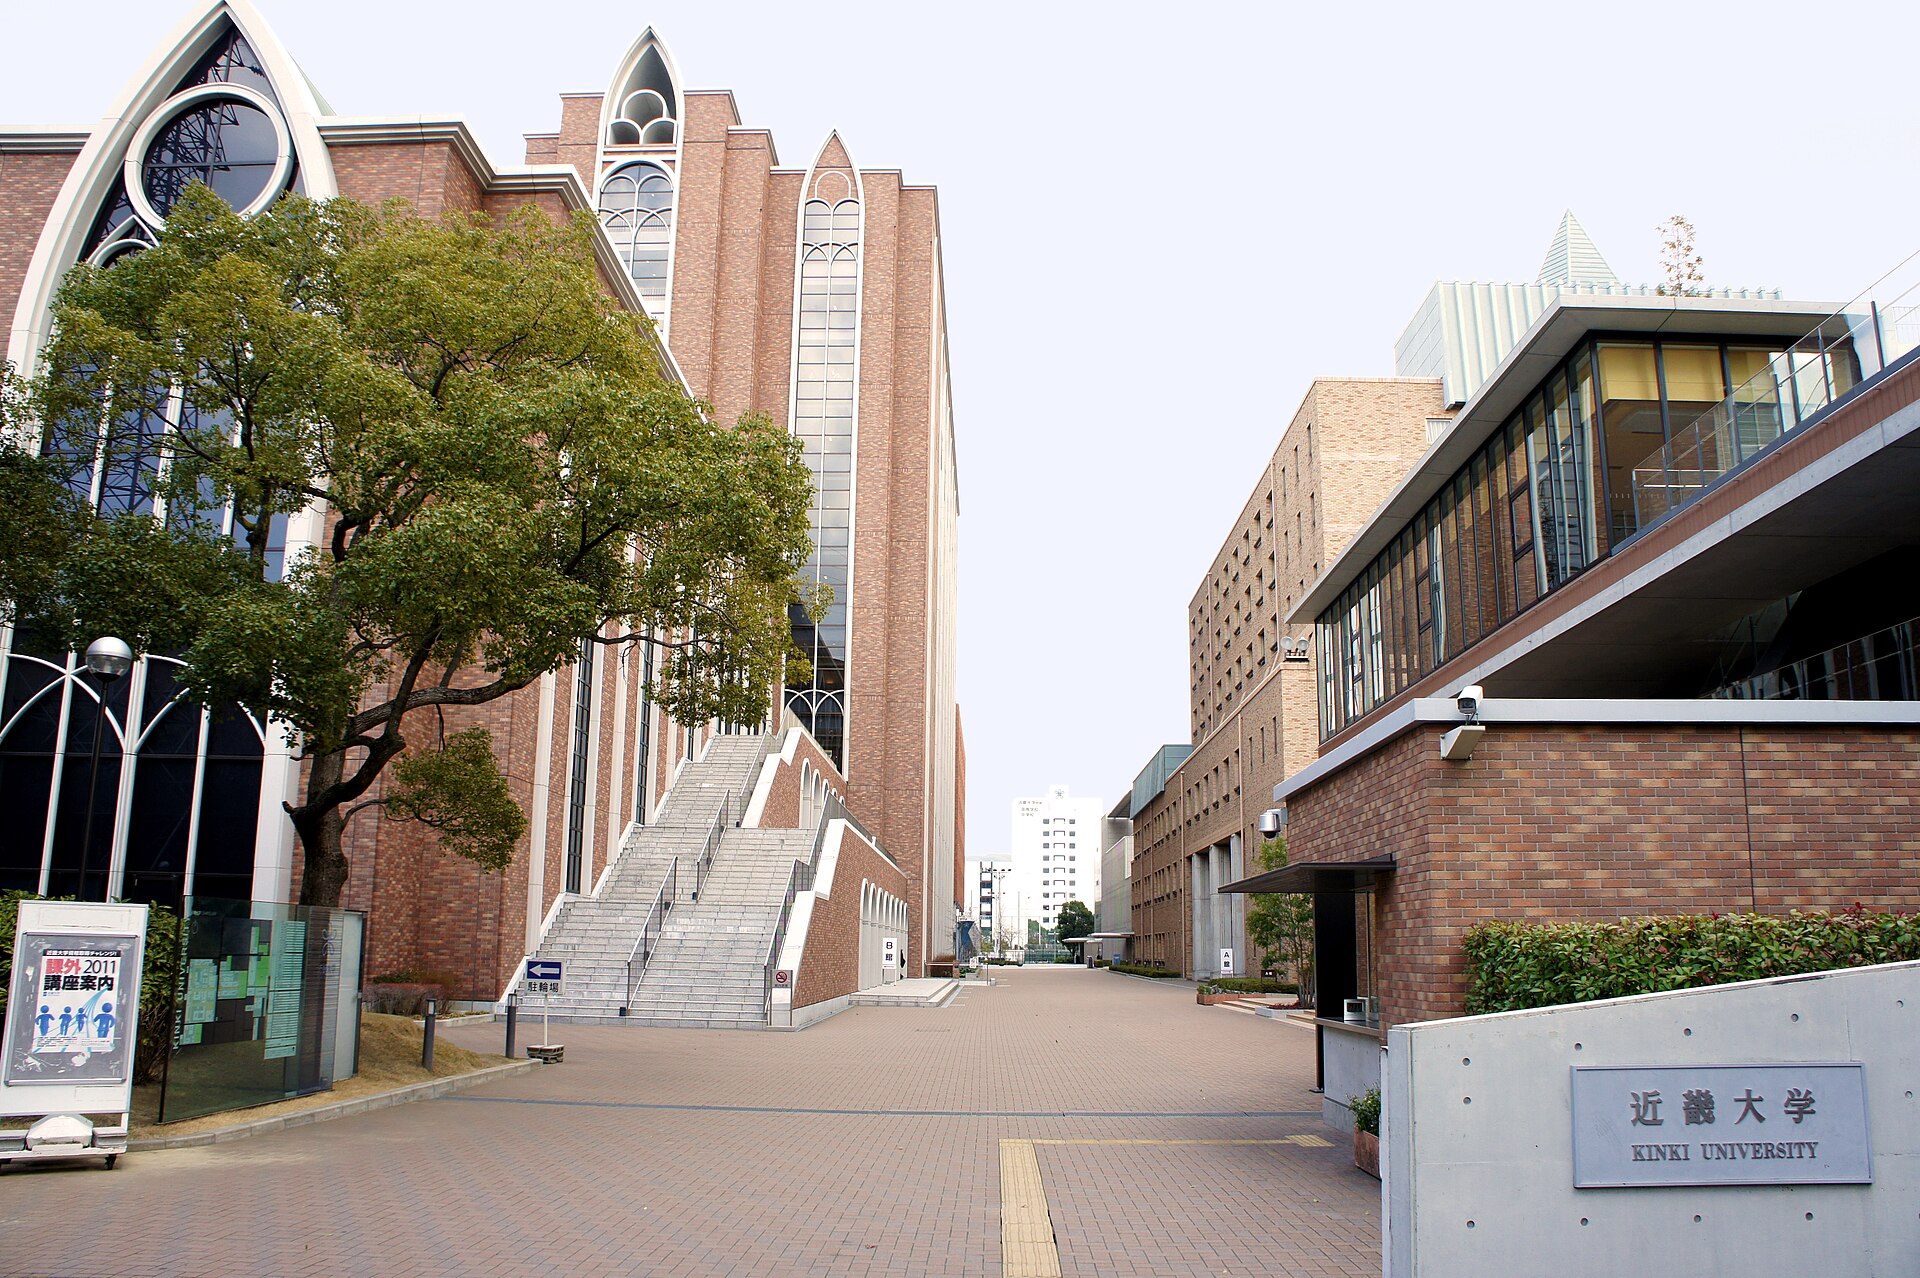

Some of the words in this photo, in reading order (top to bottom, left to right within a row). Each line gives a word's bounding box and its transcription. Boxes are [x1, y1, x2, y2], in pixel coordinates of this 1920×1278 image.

[45, 958, 81, 974] 課外
[83, 959, 116, 974] 2011
[43, 975, 115, 991] 講座案内
[527, 981, 559, 993] 駐輪場
[173, 1009, 183, 1050] KINKI
[1630, 1087, 1816, 1127] 近畿大学
[1632, 1143, 1690, 1161] KINKI
[1700, 1141, 1819, 1160] UNIVERSITY
